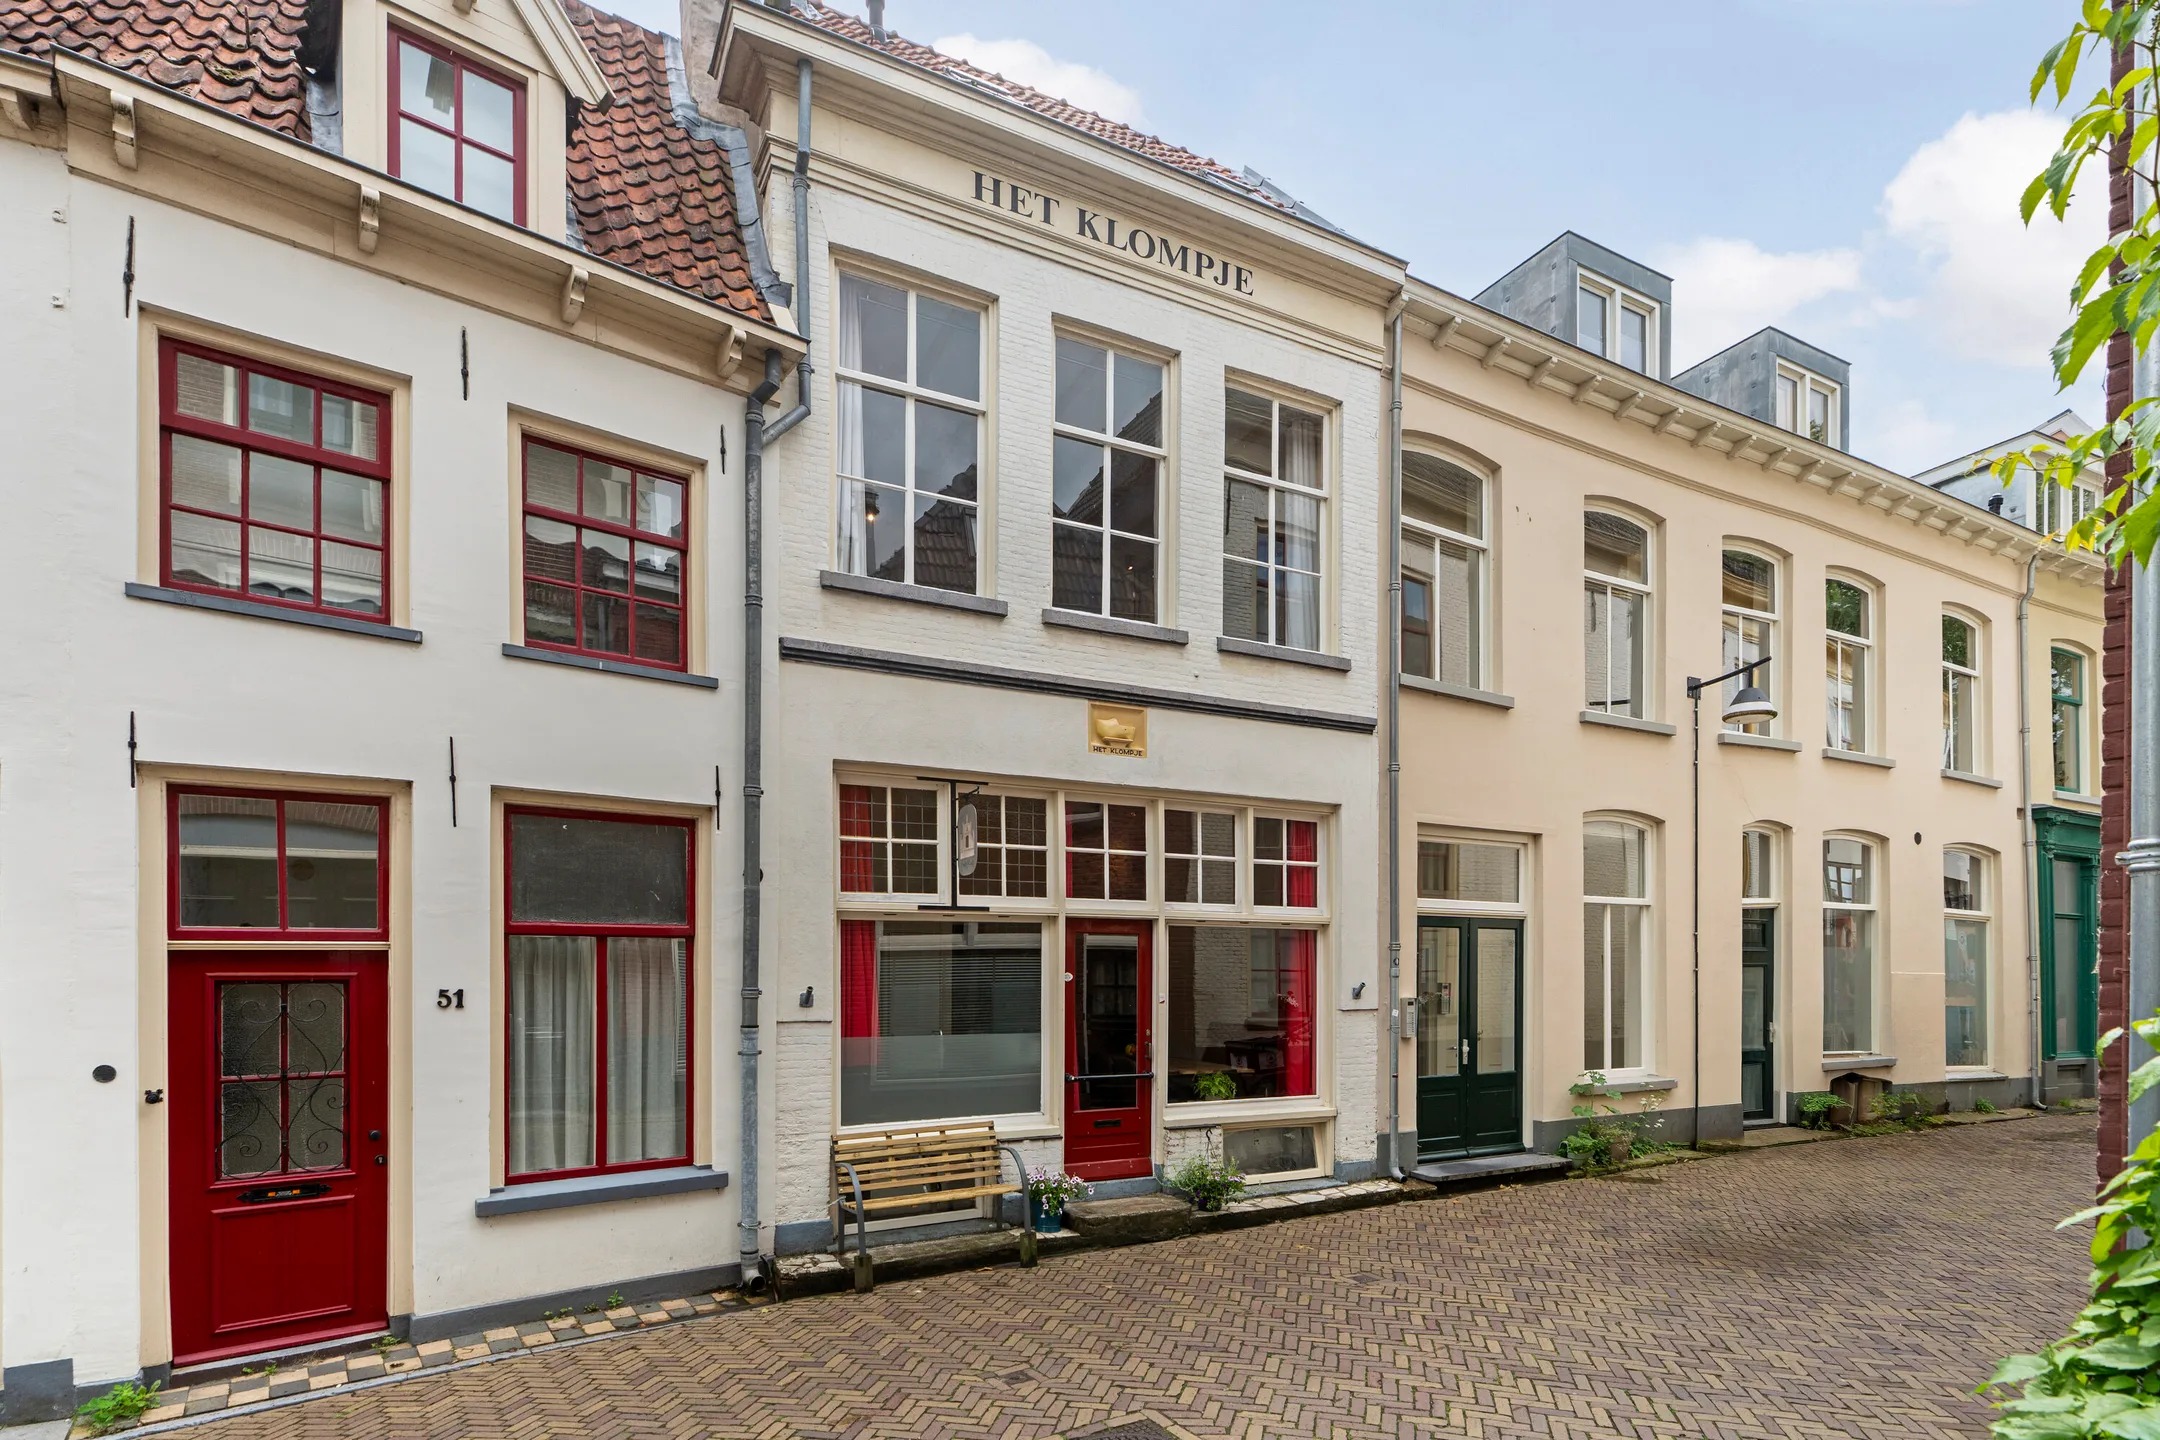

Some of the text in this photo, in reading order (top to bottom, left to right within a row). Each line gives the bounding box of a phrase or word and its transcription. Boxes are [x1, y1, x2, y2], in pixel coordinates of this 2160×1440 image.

[971, 170, 1254, 296] HET KLOMPJE
[1110, 748, 1143, 756] KLOMPJE
[437, 989, 464, 1008] 51
